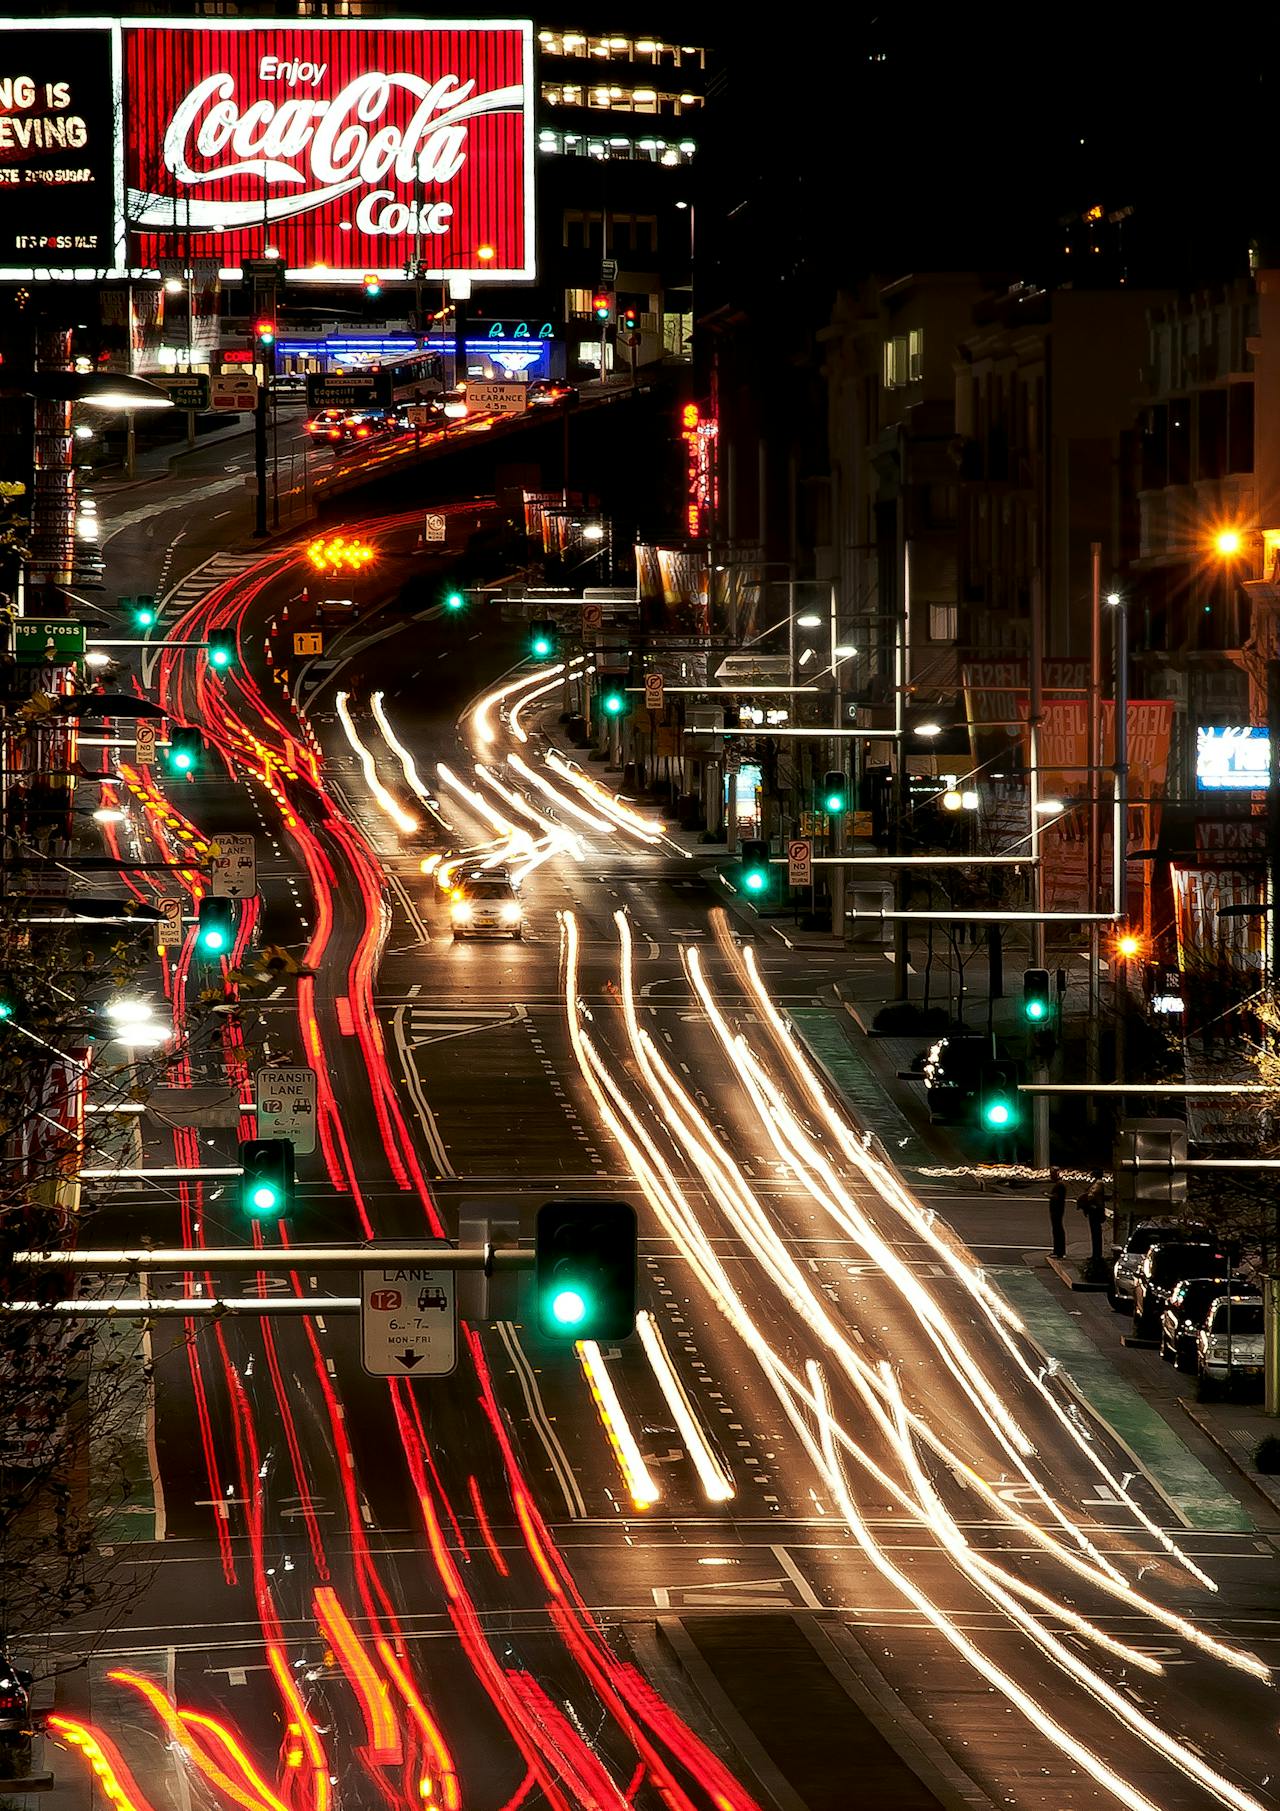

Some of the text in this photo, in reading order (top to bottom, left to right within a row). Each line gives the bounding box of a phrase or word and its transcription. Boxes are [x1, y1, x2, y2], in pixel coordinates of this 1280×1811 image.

[259, 56, 327, 87] Enjoy
[45, 82, 71, 109] IS
[163, 72, 476, 184] Coca-Cola
[356, 190, 454, 236] Coke
[487, 386, 505, 394] LOW
[469, 394, 523, 402] CLEARANCE
[16, 624, 80, 635] ngs Cross
[221, 847, 246, 855] LANE
[163, 921, 177, 929] NO
[261, 1073, 312, 1083] TRANSIT
[270, 1085, 303, 1095] LANE
[265, 1101, 281, 1112] T2
[384, 1269, 434, 1282] LANE
[375, 1291, 398, 1309] T2
[387, 1336, 432, 1344] MON-FRI
